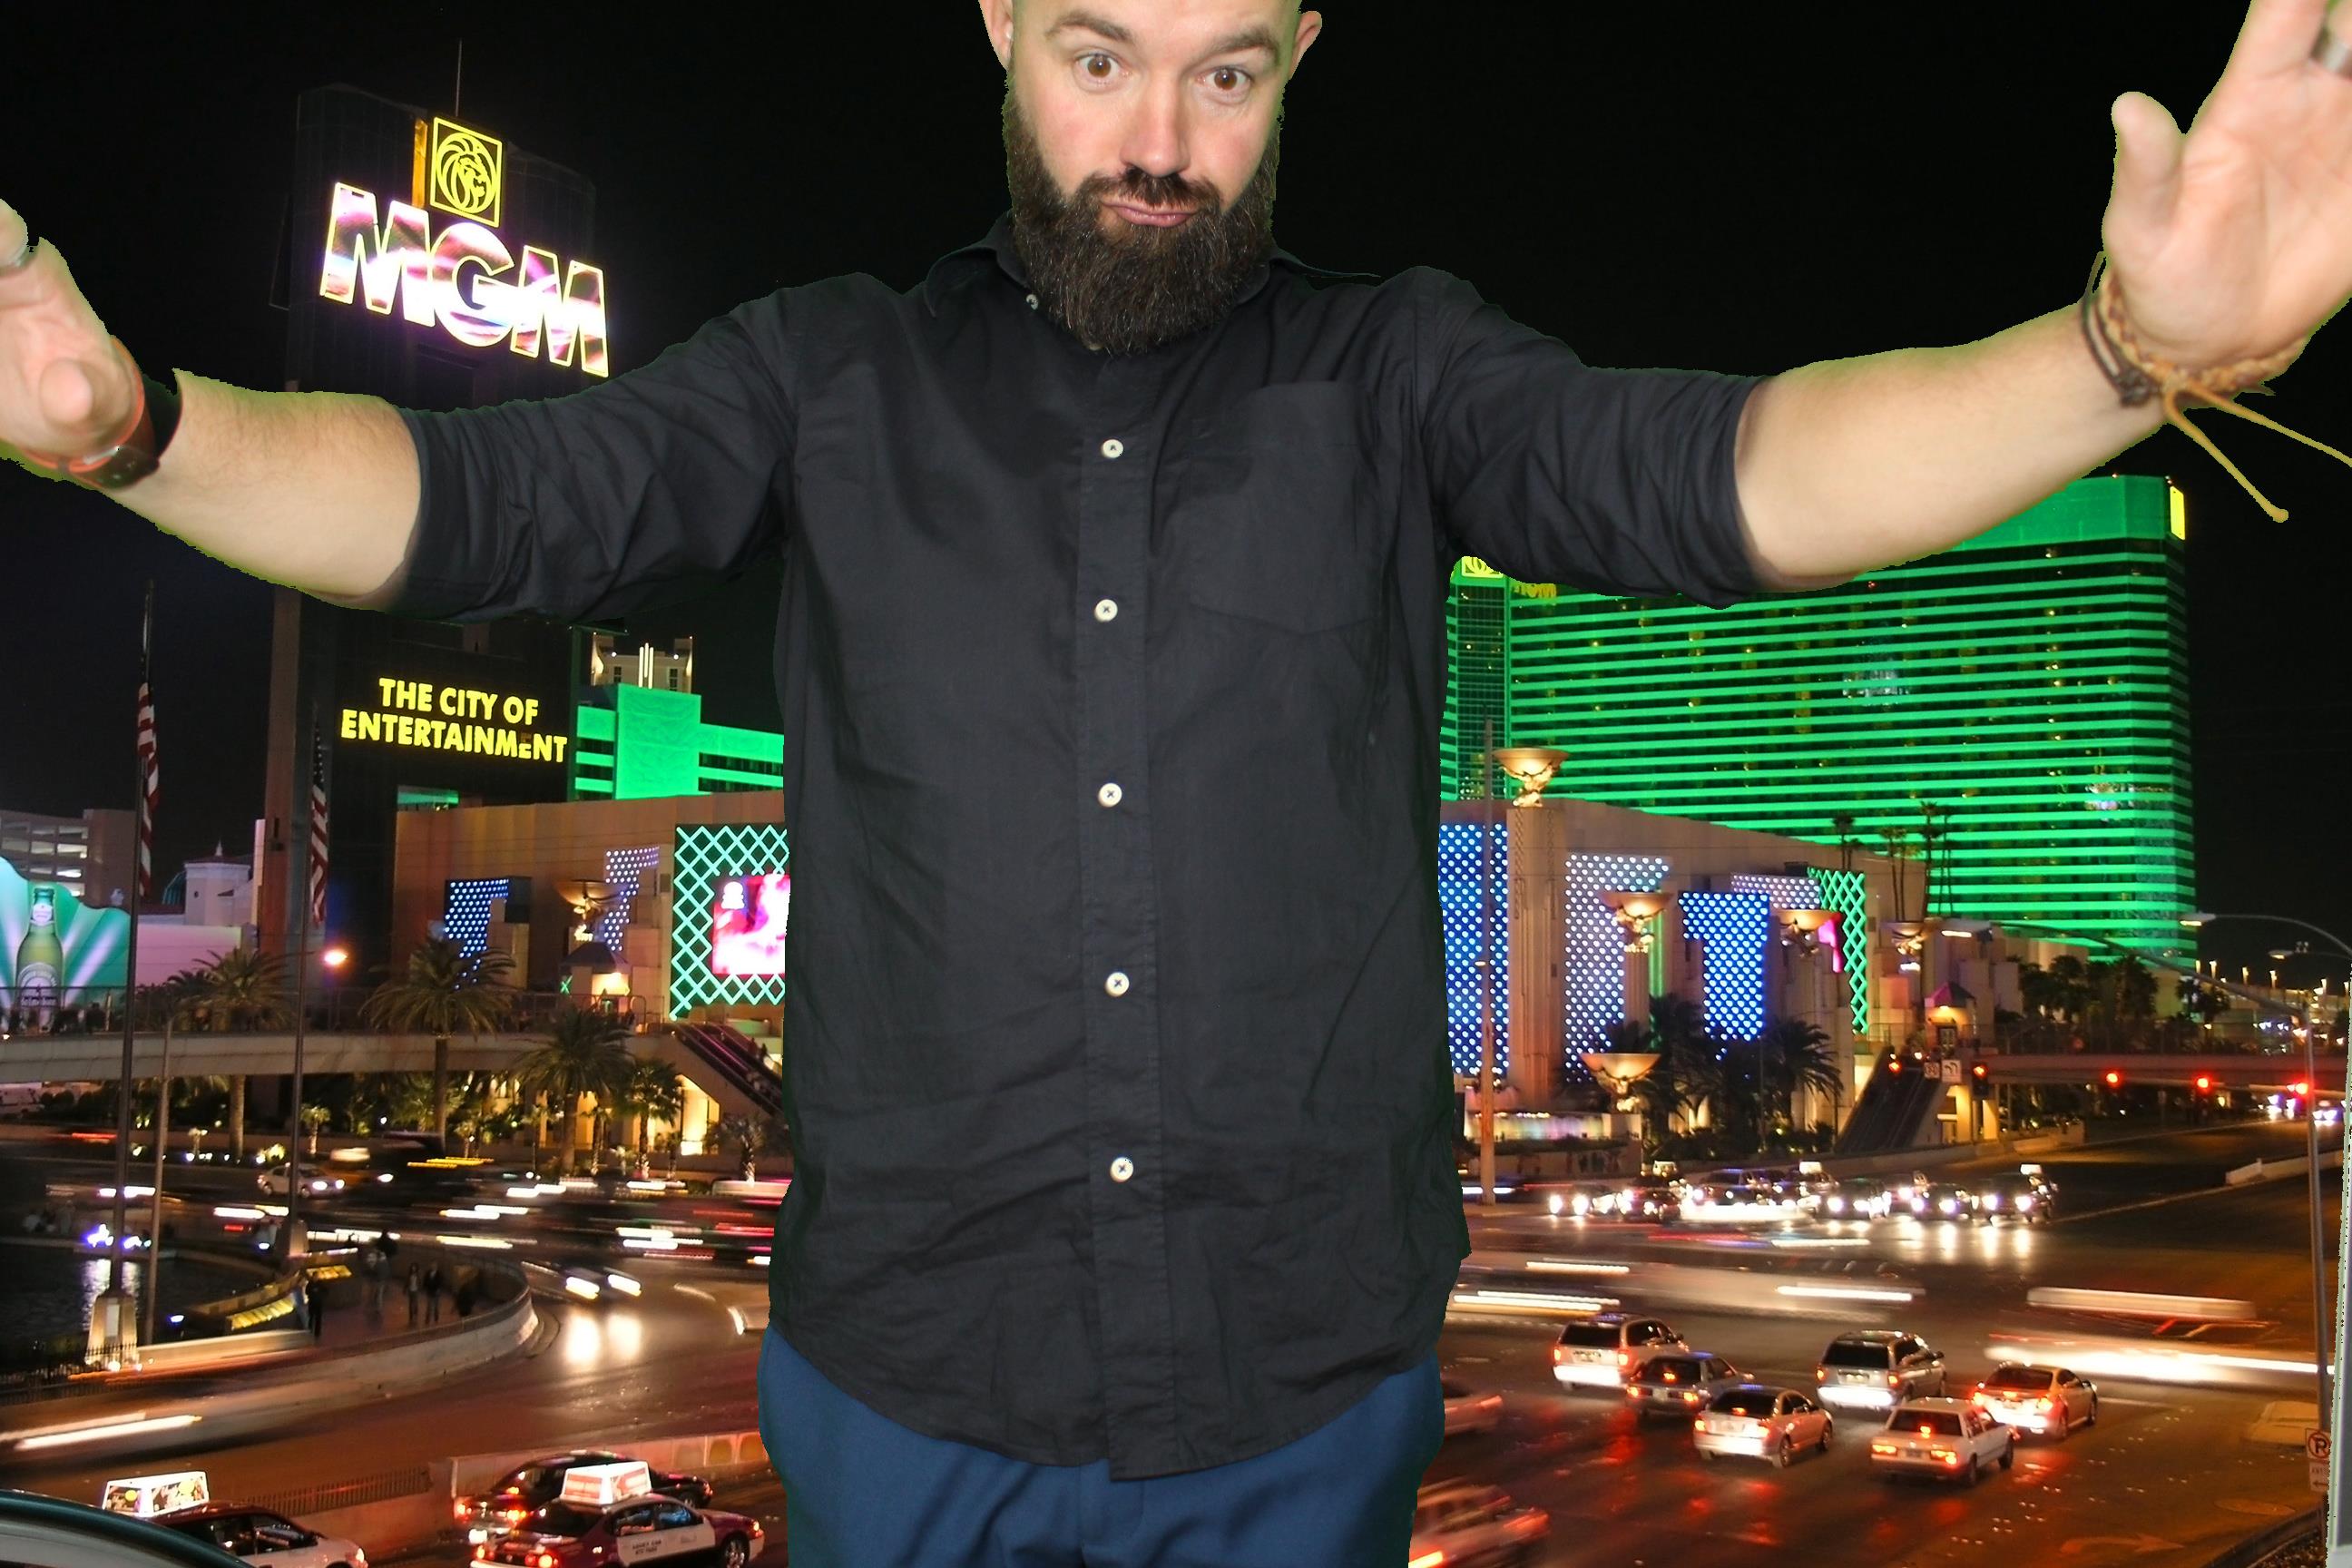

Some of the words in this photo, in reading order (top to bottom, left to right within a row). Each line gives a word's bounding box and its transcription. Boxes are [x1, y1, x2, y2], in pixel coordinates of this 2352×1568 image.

[319, 182, 609, 377] MGM
[378, 678, 433, 711] THE
[439, 687, 498, 720] CITY
[503, 696, 539, 725] OF
[340, 709, 568, 762] ENTERTAINMENT
